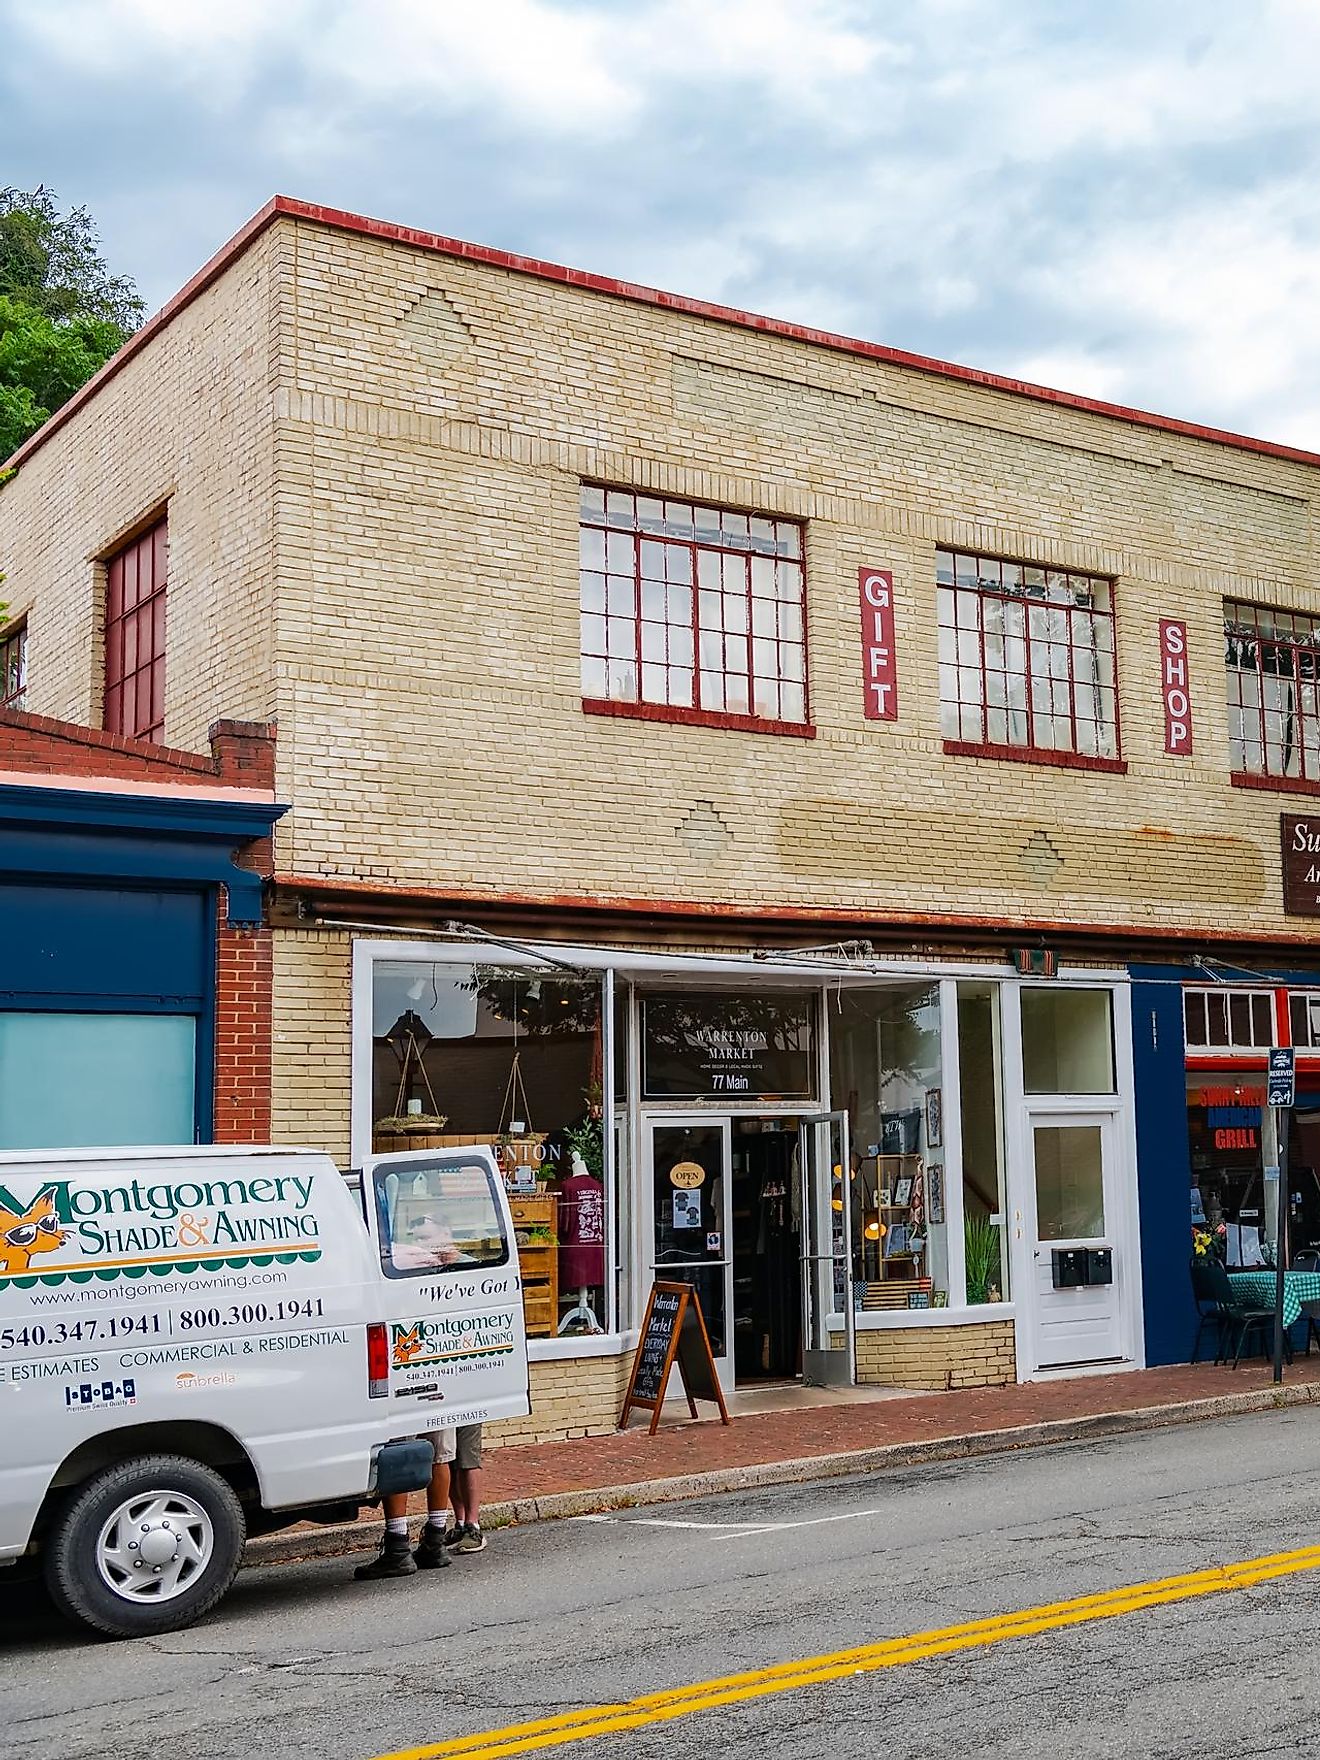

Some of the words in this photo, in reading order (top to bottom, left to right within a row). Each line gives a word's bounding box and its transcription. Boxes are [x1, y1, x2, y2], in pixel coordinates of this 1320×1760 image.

[864, 574, 894, 715] GIFT
[1164, 625, 1189, 749] SHOP
[696, 1030, 767, 1042] WARRENTON
[709, 1047, 754, 1060] MARKET
[712, 1075, 725, 1090] 77
[726, 1075, 749, 1090] Main
[1269, 1069, 1293, 1077] RESERVED
[1215, 1129, 1257, 1150] GRILL
[675, 1171, 699, 1180] OPEN
[0, 1175, 315, 1225] Montgomery
[78, 1220, 178, 1254] SHADE
[177, 1213, 210, 1247] &
[212, 1211, 319, 1244] AWNING
[29, 1269, 288, 1306] www.montgomeryawning.com
[480, 1279, 508, 1295] Got
[1, 1312, 161, 1350] 540.347.1941
[179, 1297, 325, 1331] 800.300.1941
[390, 1312, 514, 1345] Montgomery
[119, 1343, 238, 1369] COMMERCIAL
[242, 1341, 254, 1354] &
[258, 1329, 350, 1353] RESIDENTIAL
[426, 1337, 462, 1354] SHADE
[462, 1337, 472, 1349] &
[473, 1331, 514, 1348] AWNING
[11, 1357, 99, 1381] ESTIMATES
[175, 1373, 236, 1390] sunbrella
[426, 1416, 446, 1429] FREE
[447, 1409, 489, 1424] ESTIMATES
